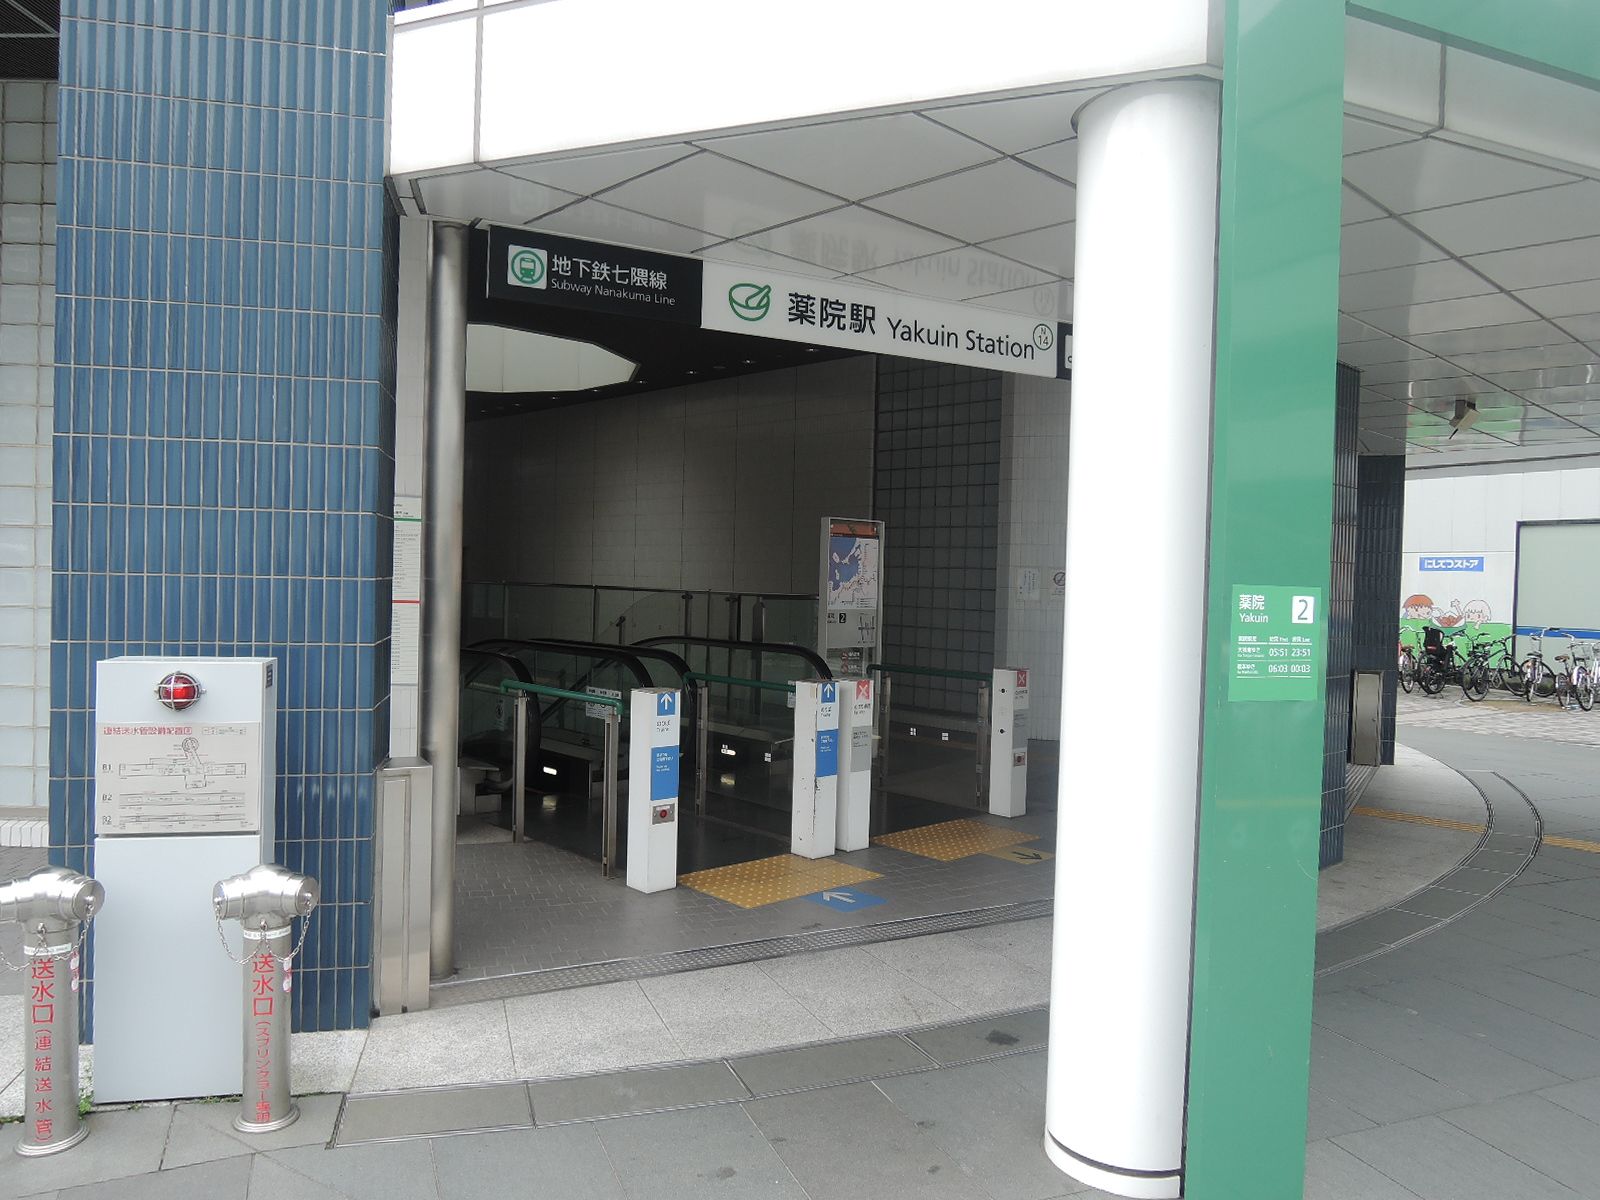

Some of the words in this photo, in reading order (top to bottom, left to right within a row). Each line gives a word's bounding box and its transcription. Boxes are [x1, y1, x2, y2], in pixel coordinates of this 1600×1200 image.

[551, 254, 668, 290] 地下鉄七隈線
[551, 278, 592, 296] Subway
[594, 285, 651, 303] Nanakuma
[654, 293, 676, 306] Line
[788, 291, 877, 335] 薬院駅
[887, 316, 959, 349] Yakuin
[965, 329, 1035, 360] Station
[1038, 335, 1049, 346] 14
[1424, 559, 1480, 569] にしてつストア
[1239, 594, 1265, 610] 薬院
[1297, 598, 1309, 621] 2
[1239, 612, 1269, 623] Yakuin
[1268, 647, 1288, 657] 05:51
[1291, 648, 1311, 657] 23:51
[1268, 664, 1288, 673] 06:03
